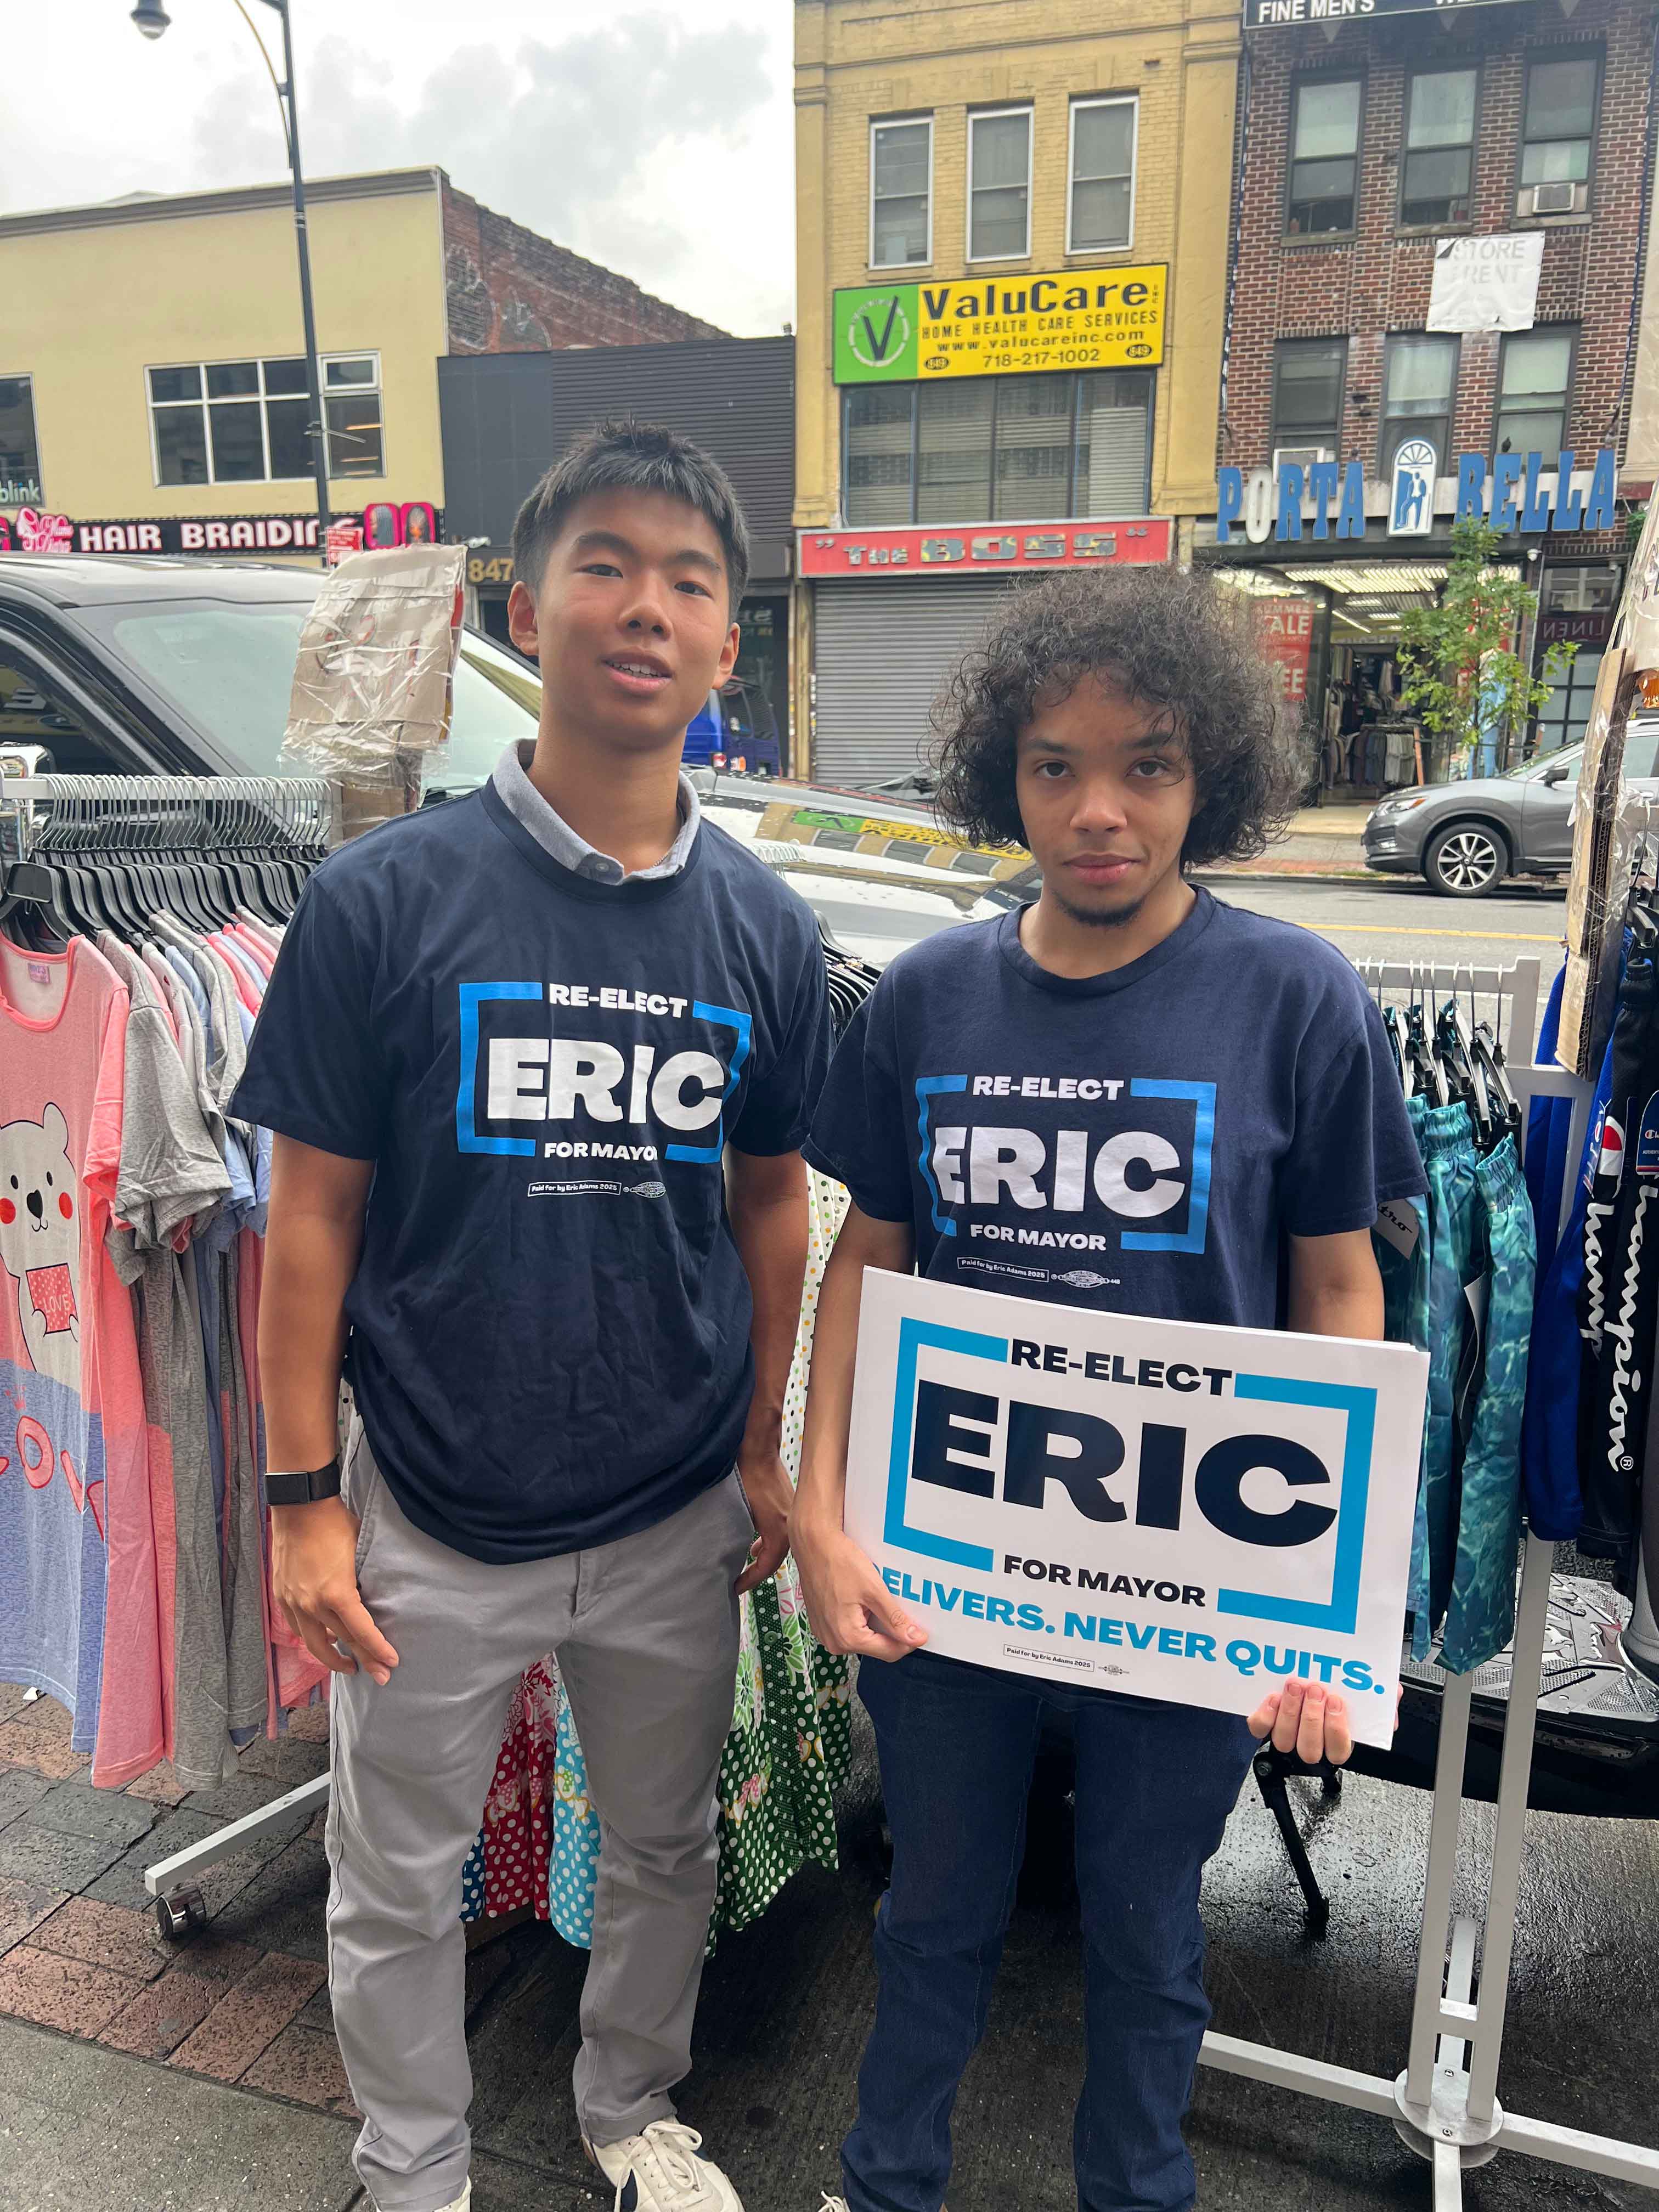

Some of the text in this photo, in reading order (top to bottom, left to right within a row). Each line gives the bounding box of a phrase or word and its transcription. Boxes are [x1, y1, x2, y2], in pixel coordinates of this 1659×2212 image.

[1259, 0, 1374, 23] FINE MEN'S
[1454, 239, 1526, 261] STORE
[1465, 264, 1523, 284] RENT
[923, 280, 1148, 321] ValuCare
[922, 310, 1158, 339] HOME HEALTH CARE SERVICES
[983, 349, 1100, 368] 718-217-1002
[1216, 462, 1365, 544] PORTA
[1454, 449, 1615, 533] BELLA
[80, 524, 162, 551] HAIR
[180, 518, 358, 550] BRAIDI
[468, 558, 514, 583] 847
[1268, 615, 1310, 635] ALE
[549, 983, 688, 1018] RE-ELECT
[487, 1038, 725, 1131] ERIC
[973, 1076, 1125, 1101] RE-ELECT
[544, 1142, 589, 1158] FOR
[932, 1126, 1186, 1218] ERIC
[557, 1183, 566, 1192] by
[970, 1224, 1107, 1251] FOR MAYOR
[986, 1262, 993, 1271] by
[1006, 1267, 1027, 1276] Adams
[43, 1293, 71, 1314] LOVE
[1011, 1338, 1232, 1396] RE-ELECT
[911, 1379, 1338, 1547] ERIC
[1004, 1554, 1205, 1607] FOR MAYOR
[873, 1562, 1384, 1695] ELIVERS. NEVER QUITS.
[1053, 1656, 1074, 1665] Adams
